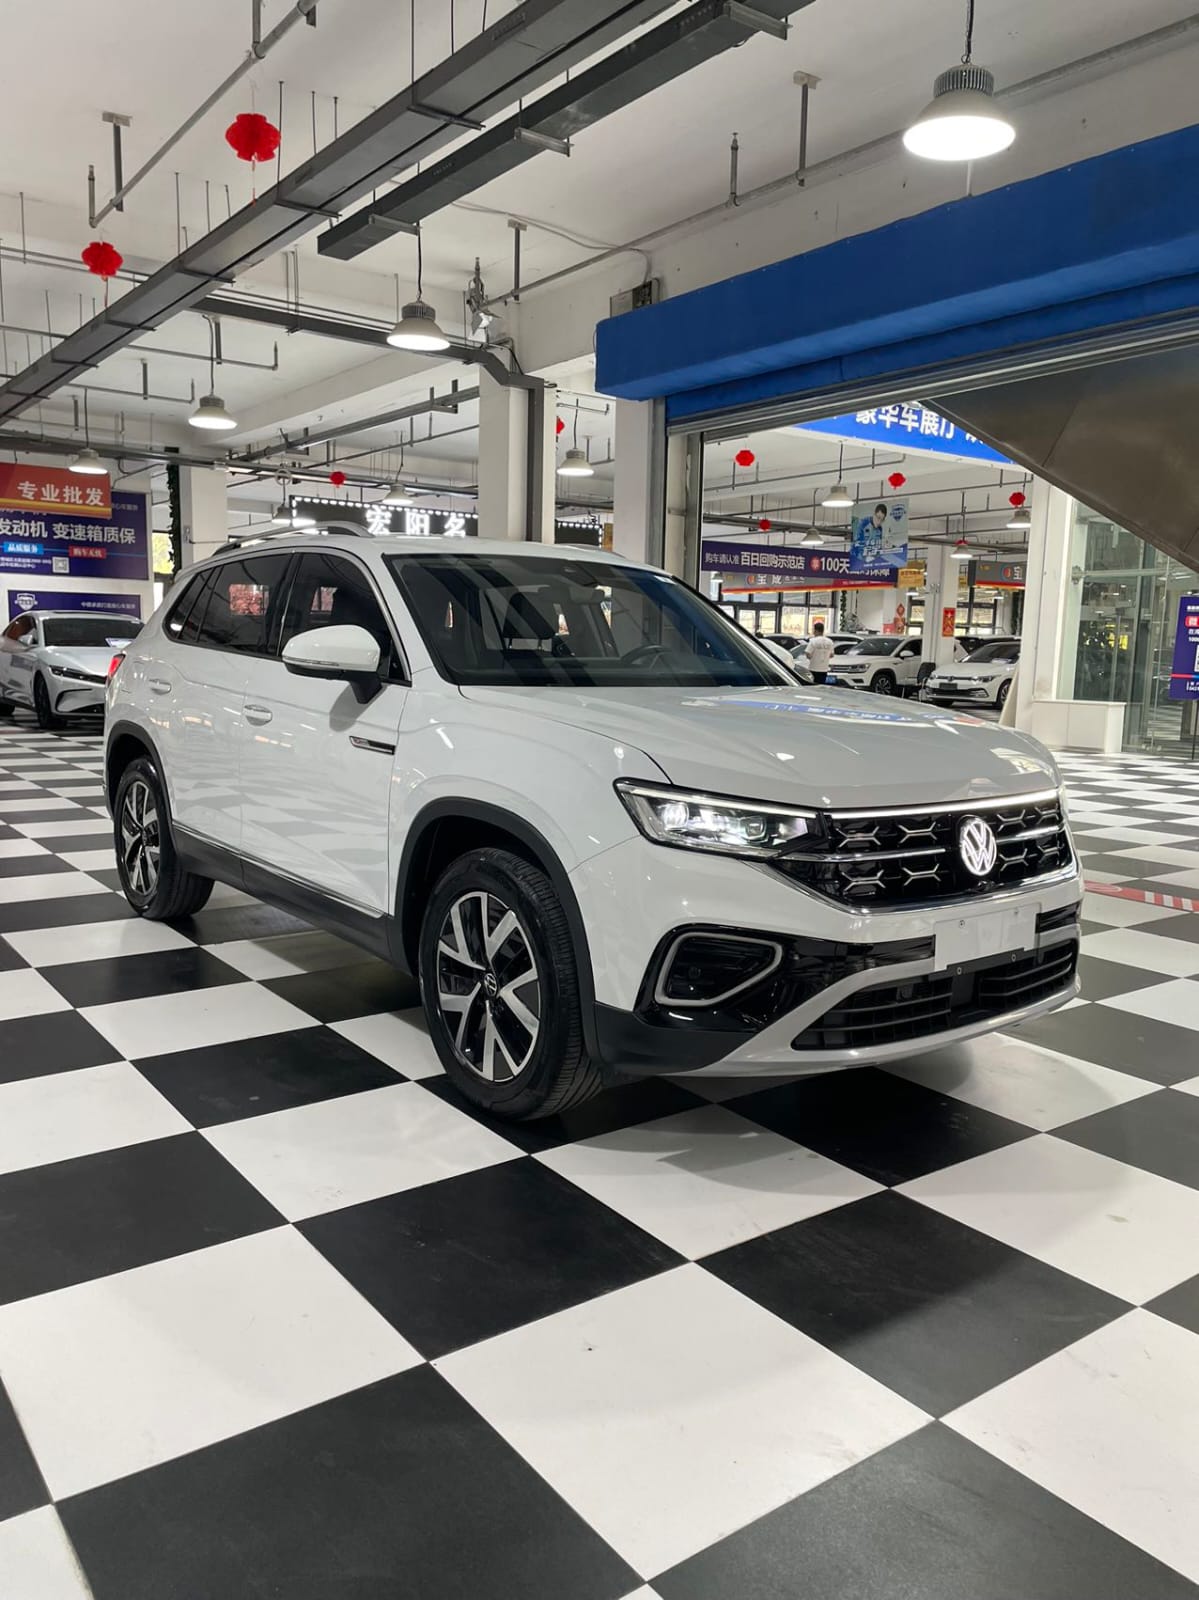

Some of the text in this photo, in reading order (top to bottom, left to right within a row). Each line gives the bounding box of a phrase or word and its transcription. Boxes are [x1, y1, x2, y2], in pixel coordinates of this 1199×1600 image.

[17, 481, 104, 506] 专业批发
[0, 519, 136, 544] 发动机 变速箱质保
[740, 551, 805, 570] 百日回购示范店
